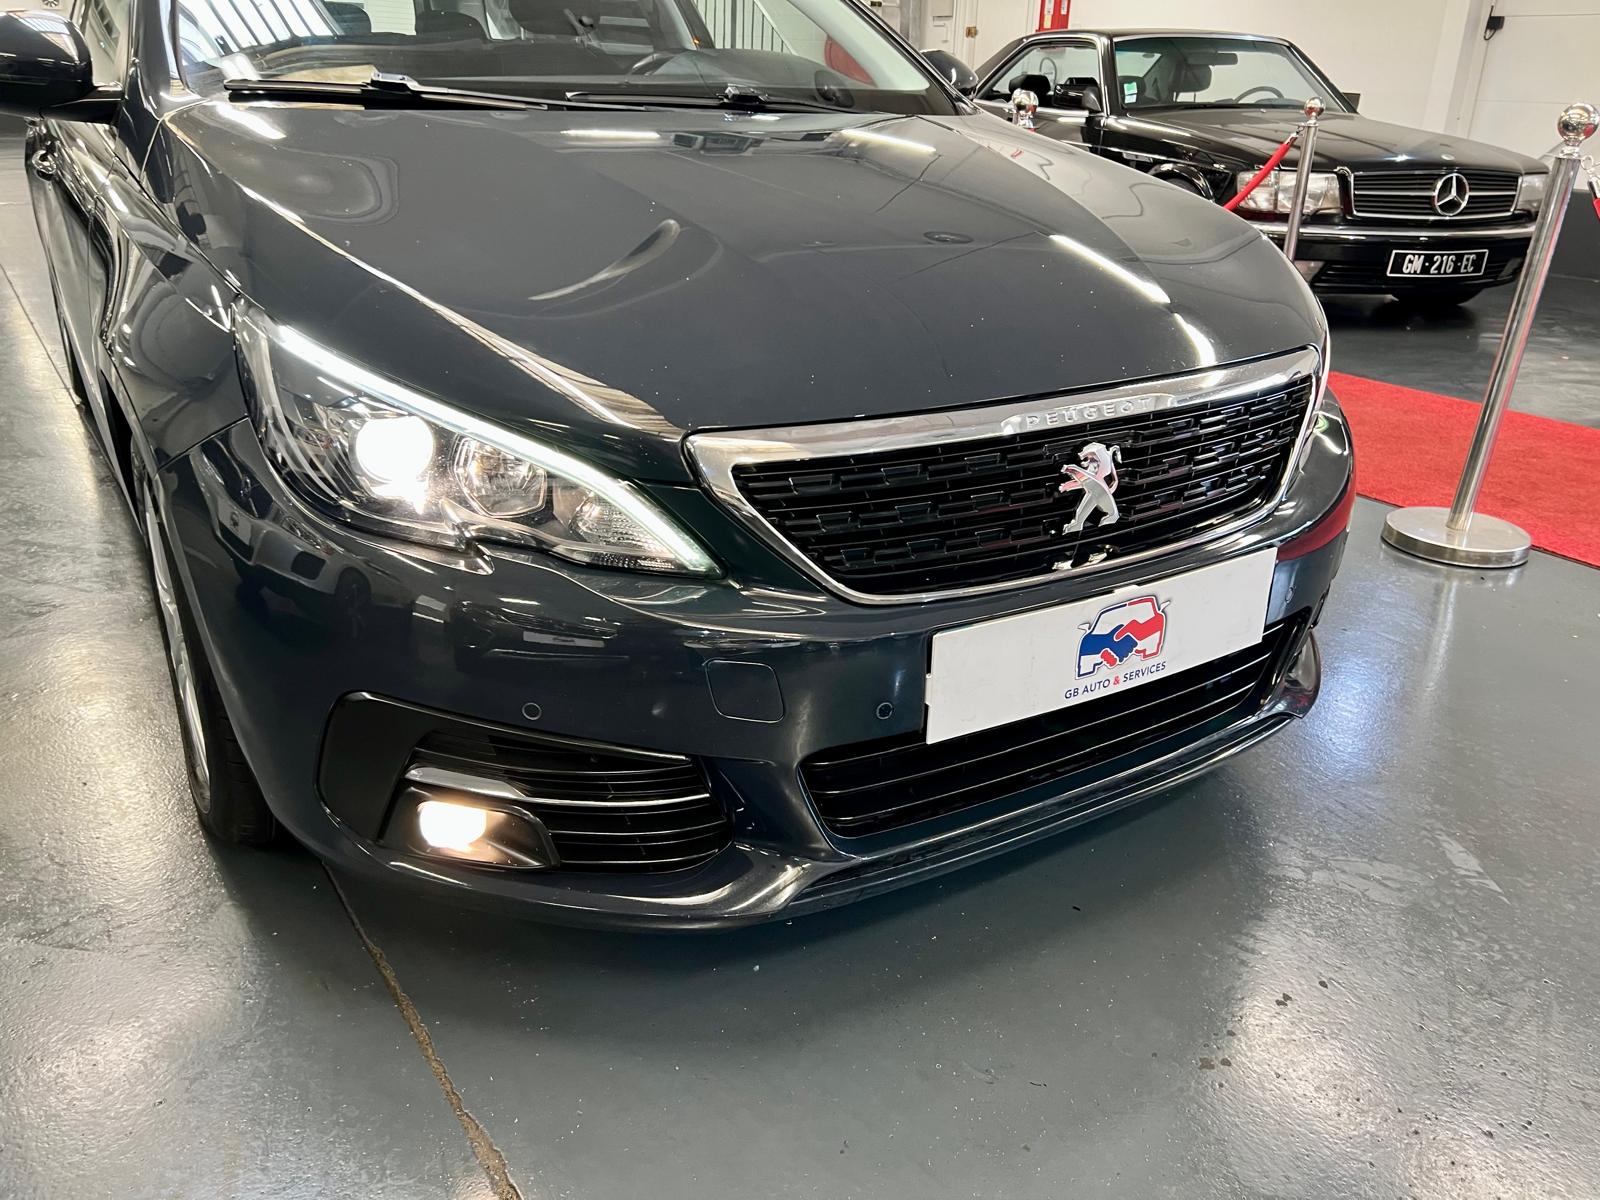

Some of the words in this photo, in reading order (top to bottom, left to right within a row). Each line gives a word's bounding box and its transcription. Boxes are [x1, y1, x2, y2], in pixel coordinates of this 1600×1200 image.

[1026, 397, 1151, 430] PEUGEOT
[1064, 687, 1080, 699] GB
[1081, 678, 1111, 695] AUTO
[1112, 675, 1120, 686] &
[1123, 661, 1166, 682] SERVICES
